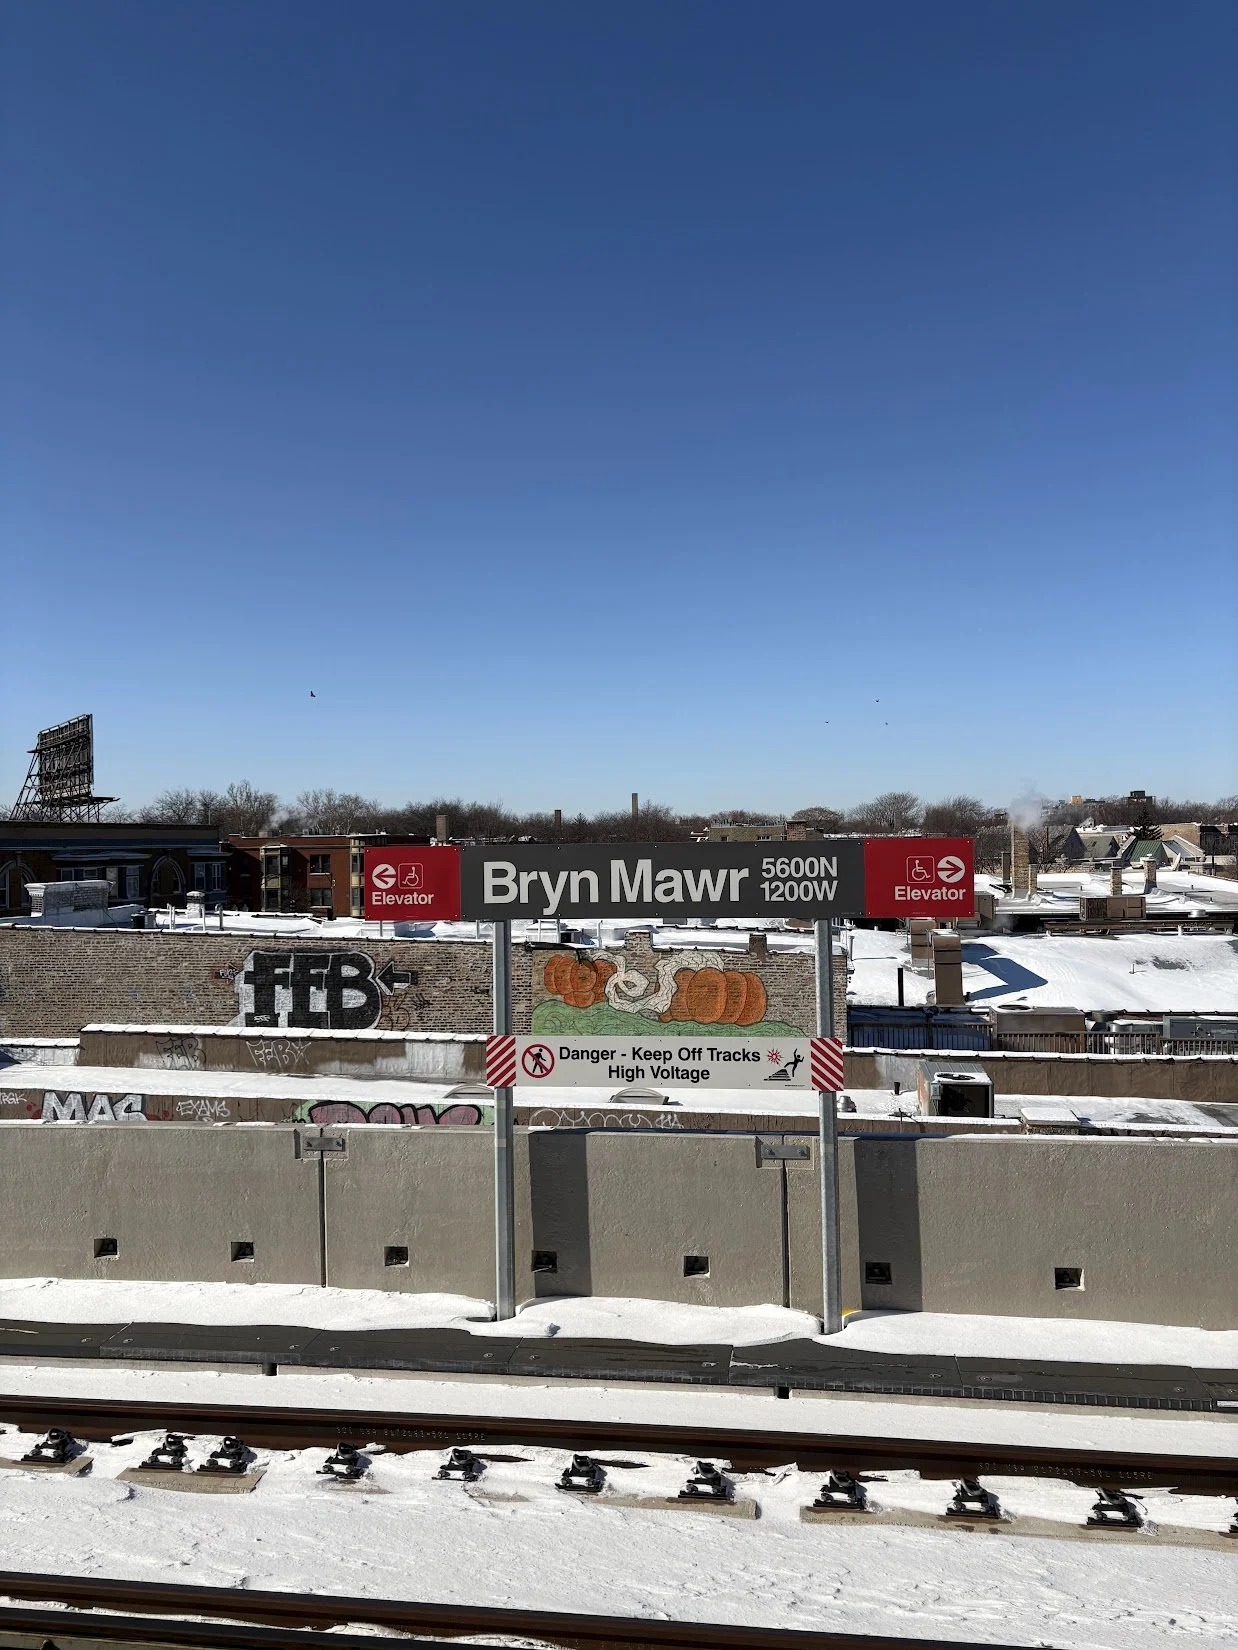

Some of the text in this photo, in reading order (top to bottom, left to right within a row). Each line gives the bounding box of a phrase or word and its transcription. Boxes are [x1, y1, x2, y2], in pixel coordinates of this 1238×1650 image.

[761, 856, 838, 879] 5600N
[483, 858, 749, 916] Bryn Mawr
[760, 880, 838, 903] 1200W
[894, 885, 966, 902] Elevator
[371, 891, 434, 906] Elevator
[559, 1046, 617, 1064] Danger
[632, 1047, 673, 1065] Keep
[677, 1047, 703, 1062] Off
[707, 1047, 761, 1063] Tracks
[608, 1065, 710, 1083] High Voltage
